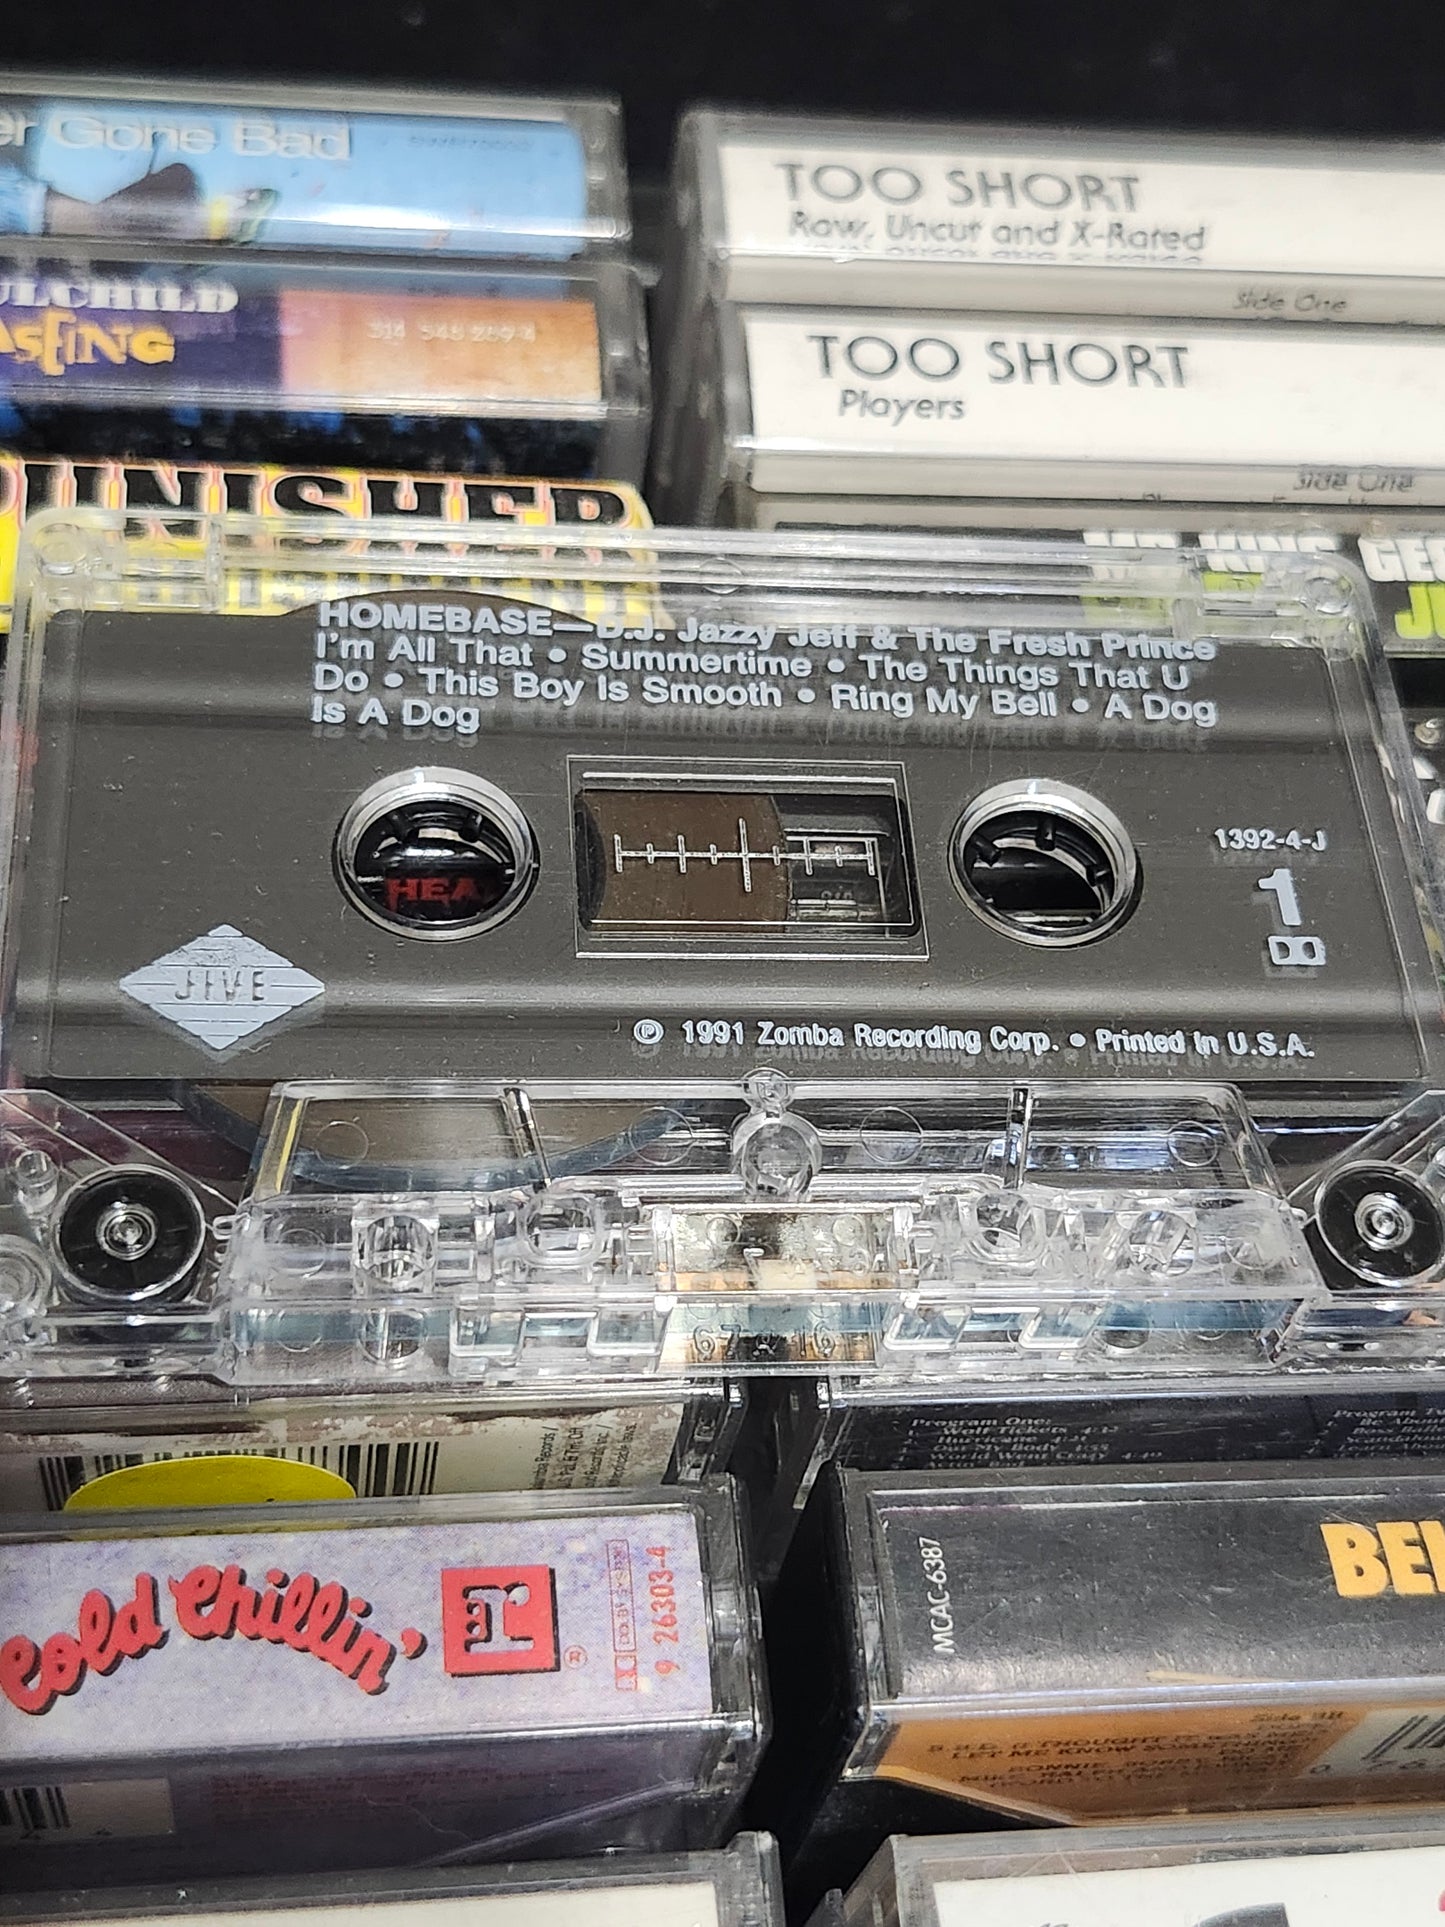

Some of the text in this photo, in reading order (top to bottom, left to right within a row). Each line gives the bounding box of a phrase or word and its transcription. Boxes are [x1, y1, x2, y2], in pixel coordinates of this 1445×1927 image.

[52, 111, 217, 154] Gone
[233, 115, 352, 161] Bad
[775, 162, 1140, 212] TOO SHORT
[787, 210, 1209, 251] Raw, Uncut and X-Rated
[1233, 290, 1347, 314] Side One
[808, 334, 1189, 388] TOO SHORT
[838, 388, 965, 427] Players
[1293, 464, 1414, 493] Side One
[677, 617, 776, 651] Jazzy
[788, 625, 858, 649] Jeff
[870, 626, 899, 651] &
[907, 627, 978, 654] The
[988, 629, 1090, 657] Fresh
[1101, 633, 1217, 662] Prince
[317, 633, 1189, 691] I'm All That Summertime The Things That U
[311, 696, 481, 735] Is A Dog
[314, 664, 1217, 728] Do This Boy Is Smooth Ring My Bell A Dog
[1214, 828, 1327, 851] 1392-4-J
[1258, 868, 1302, 926] 1
[174, 970, 266, 1002] JIVE
[681, 1020, 744, 1046] 1991
[757, 1020, 844, 1048] Zomba
[853, 1022, 981, 1055] Recording
[989, 1026, 1059, 1056] Corp.
[1095, 1028, 1186, 1055] Printed
[1193, 1030, 1220, 1057] In
[1227, 1030, 1315, 1058] U.S.A.
[912, 1417, 998, 1429] Program
[942, 1426, 988, 1436] Wolf
[1333, 1409, 1416, 1419] Program
[534, 1432, 556, 1462] Records
[645, 1545, 681, 1676] 9 26303-4
[918, 1536, 955, 1654] MCAC-6387
[0, 1564, 427, 1715] Cold Chillin'
